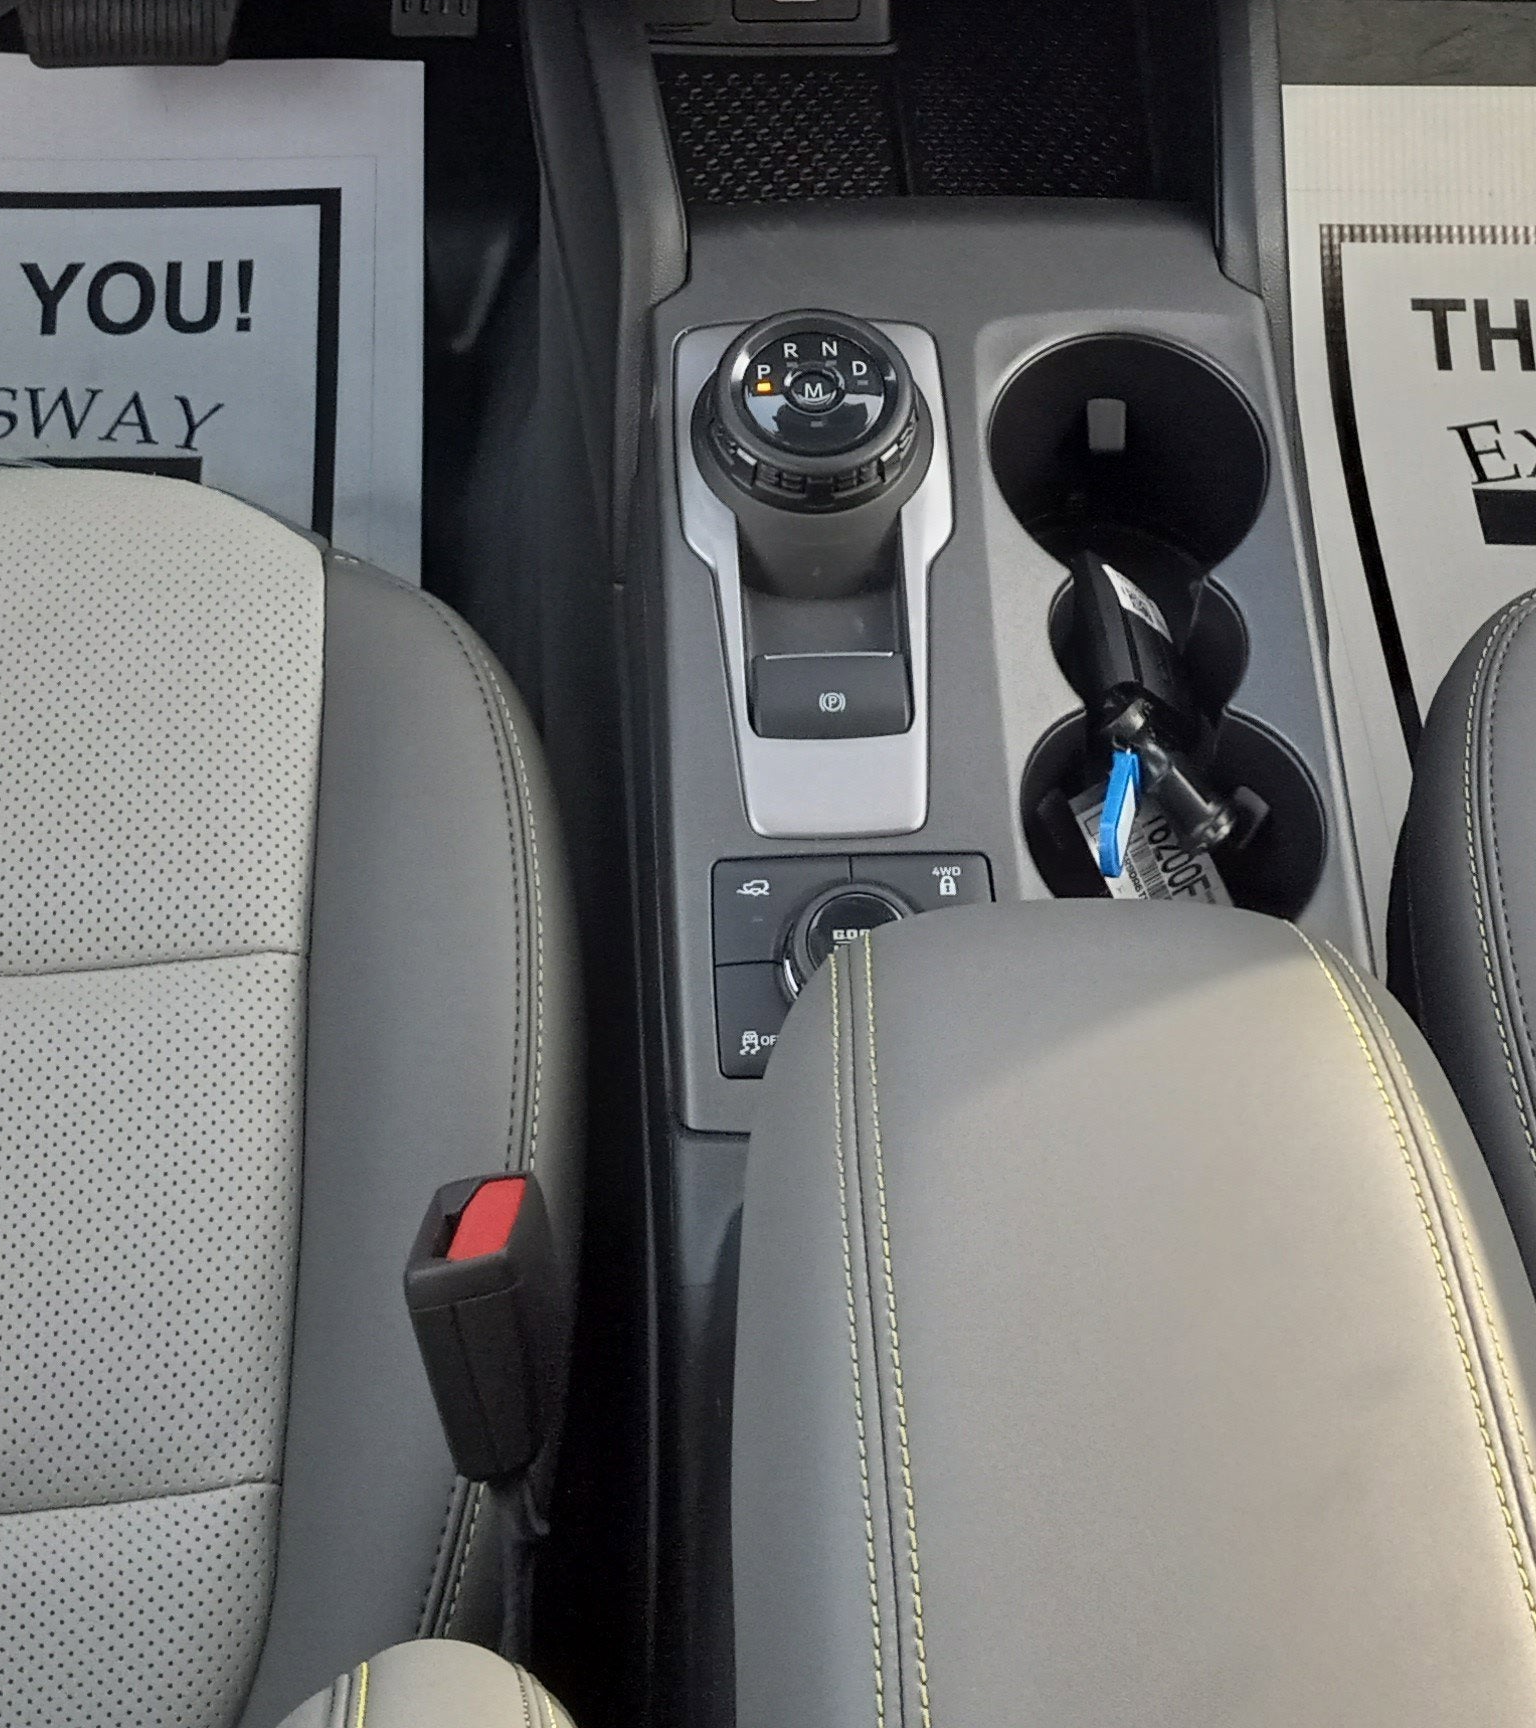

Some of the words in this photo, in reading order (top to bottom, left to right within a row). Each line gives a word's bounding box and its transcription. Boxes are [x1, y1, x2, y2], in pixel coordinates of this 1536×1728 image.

[20, 258, 255, 335] YOU!
[784, 343, 799, 358] R
[821, 341, 838, 357] N
[757, 364, 771, 379] P
[852, 361, 867, 376] D
[804, 383, 823, 399] M
[932, 866, 961, 876] 4WD
